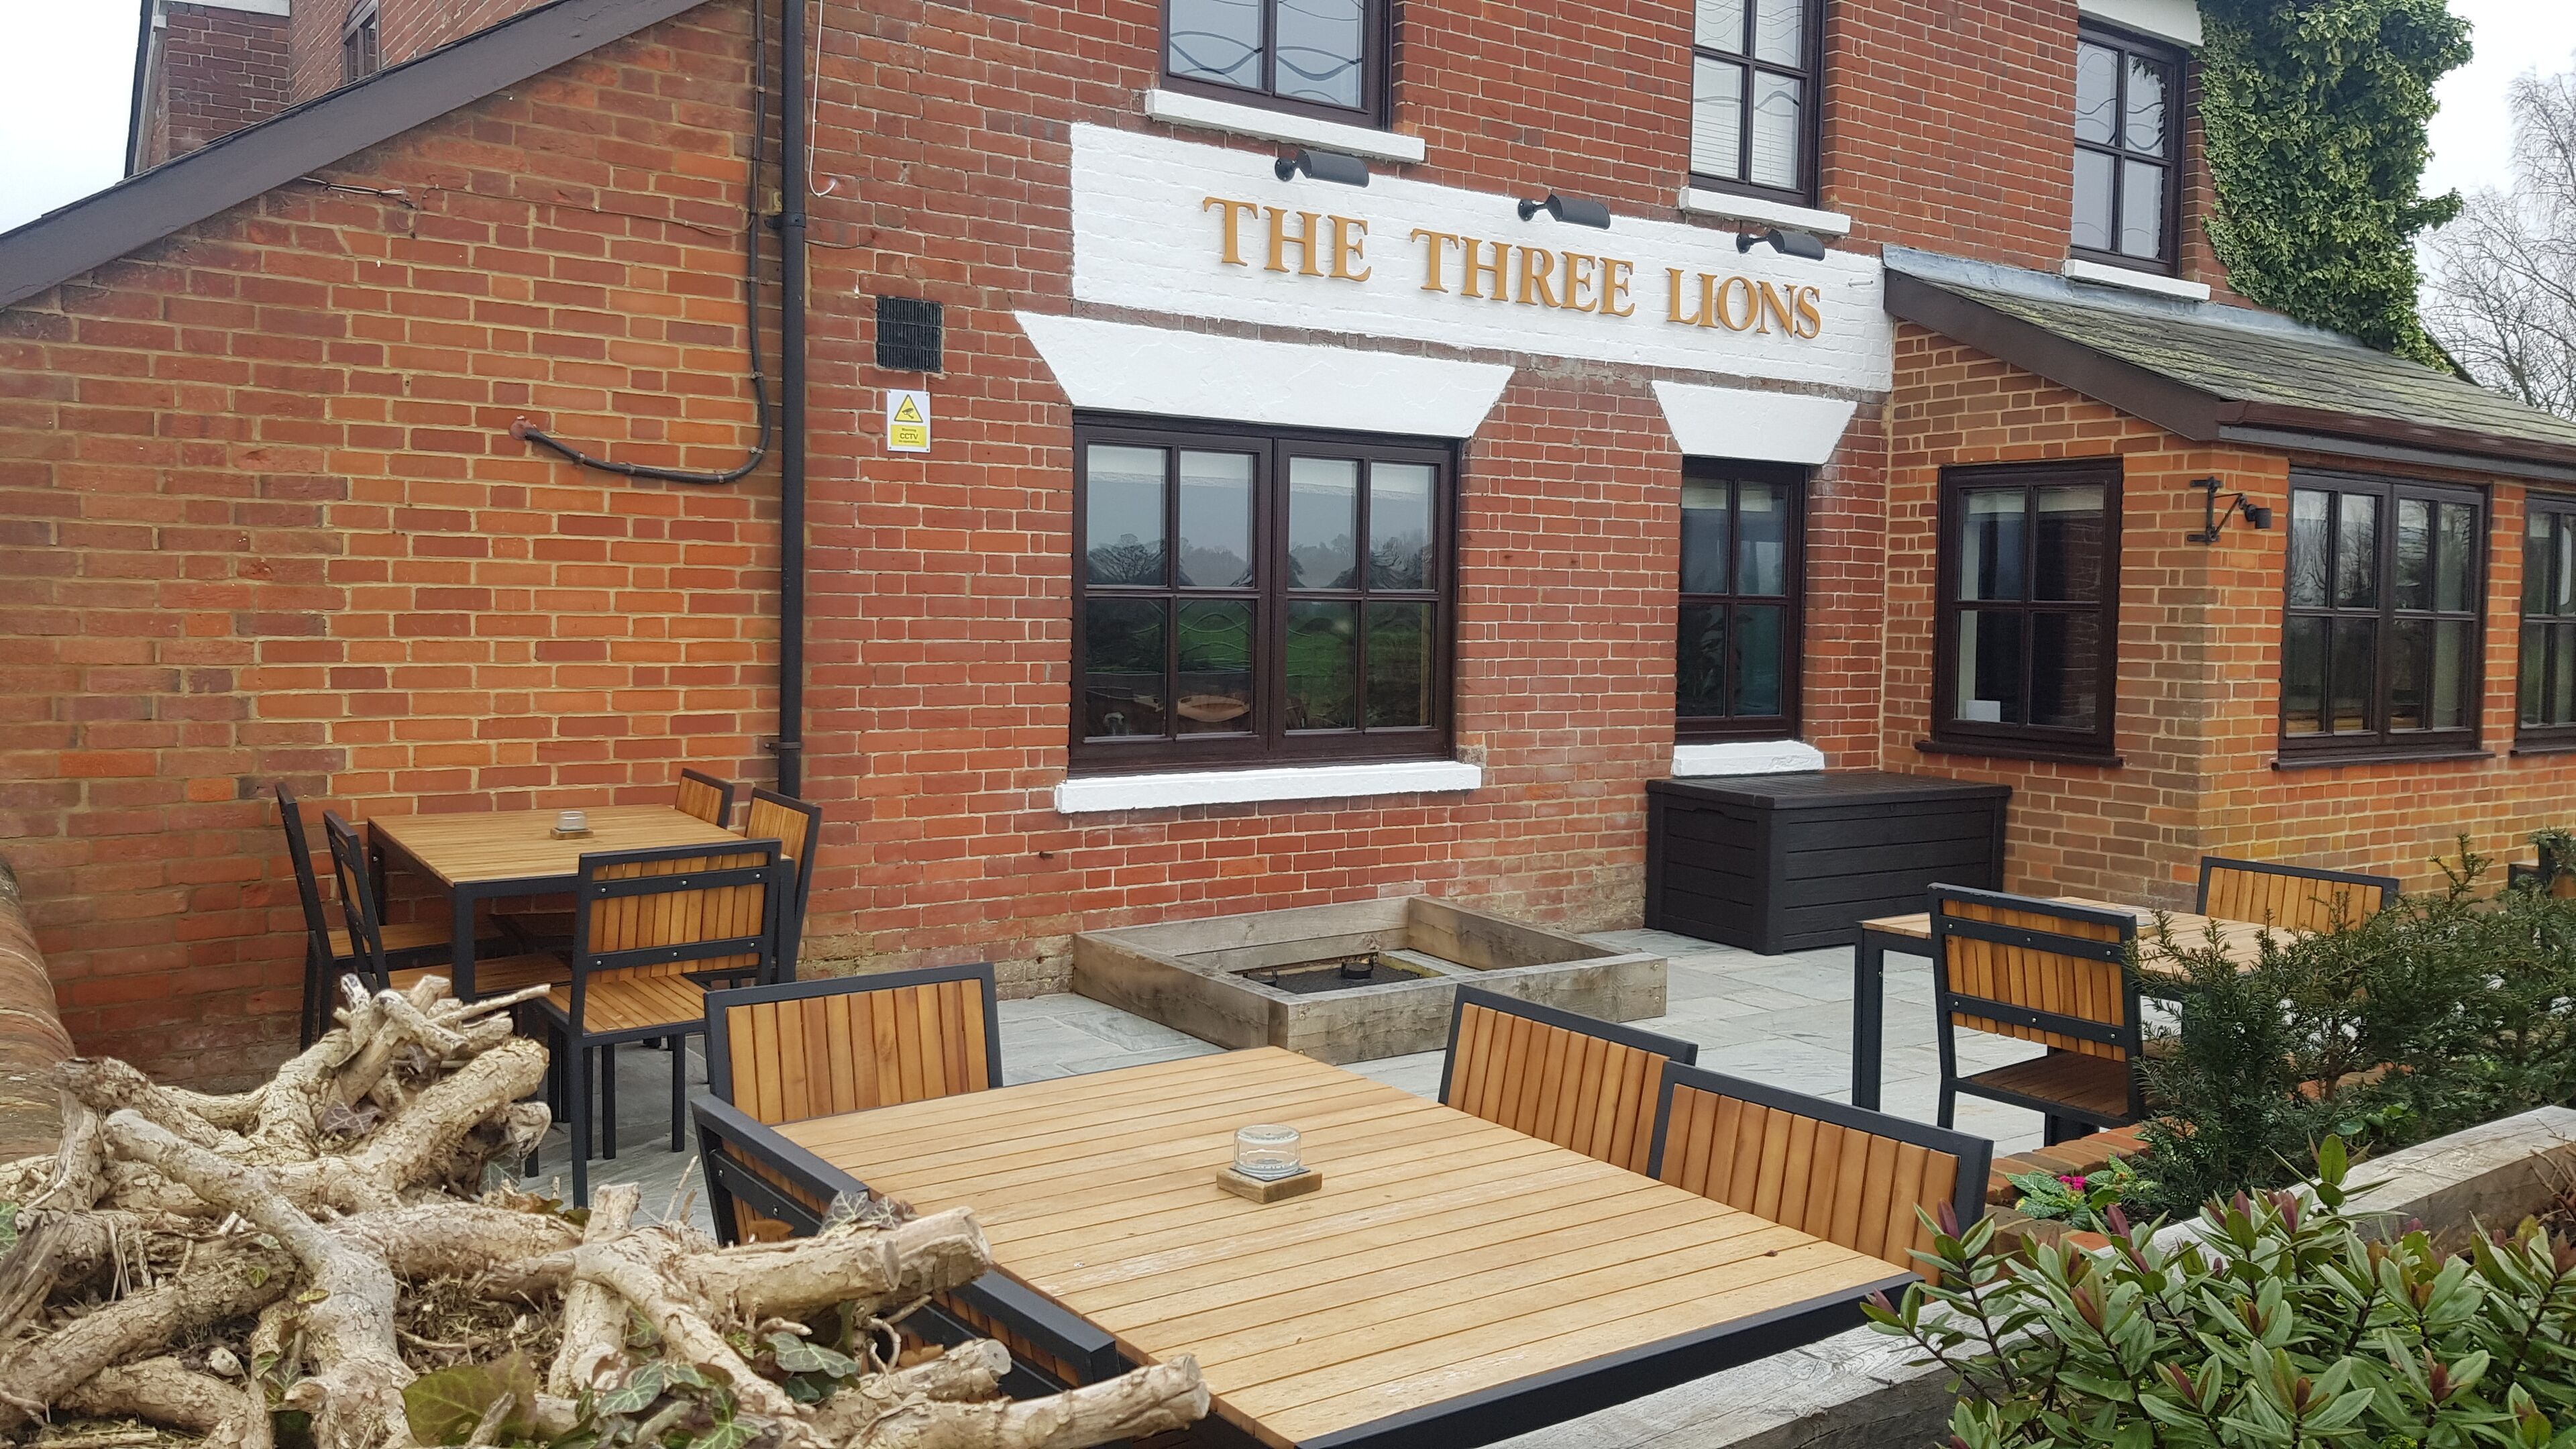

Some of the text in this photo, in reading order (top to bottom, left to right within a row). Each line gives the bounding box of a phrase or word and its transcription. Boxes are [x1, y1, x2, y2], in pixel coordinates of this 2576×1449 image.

[1203, 197, 1821, 339] THE THREE LIONS
